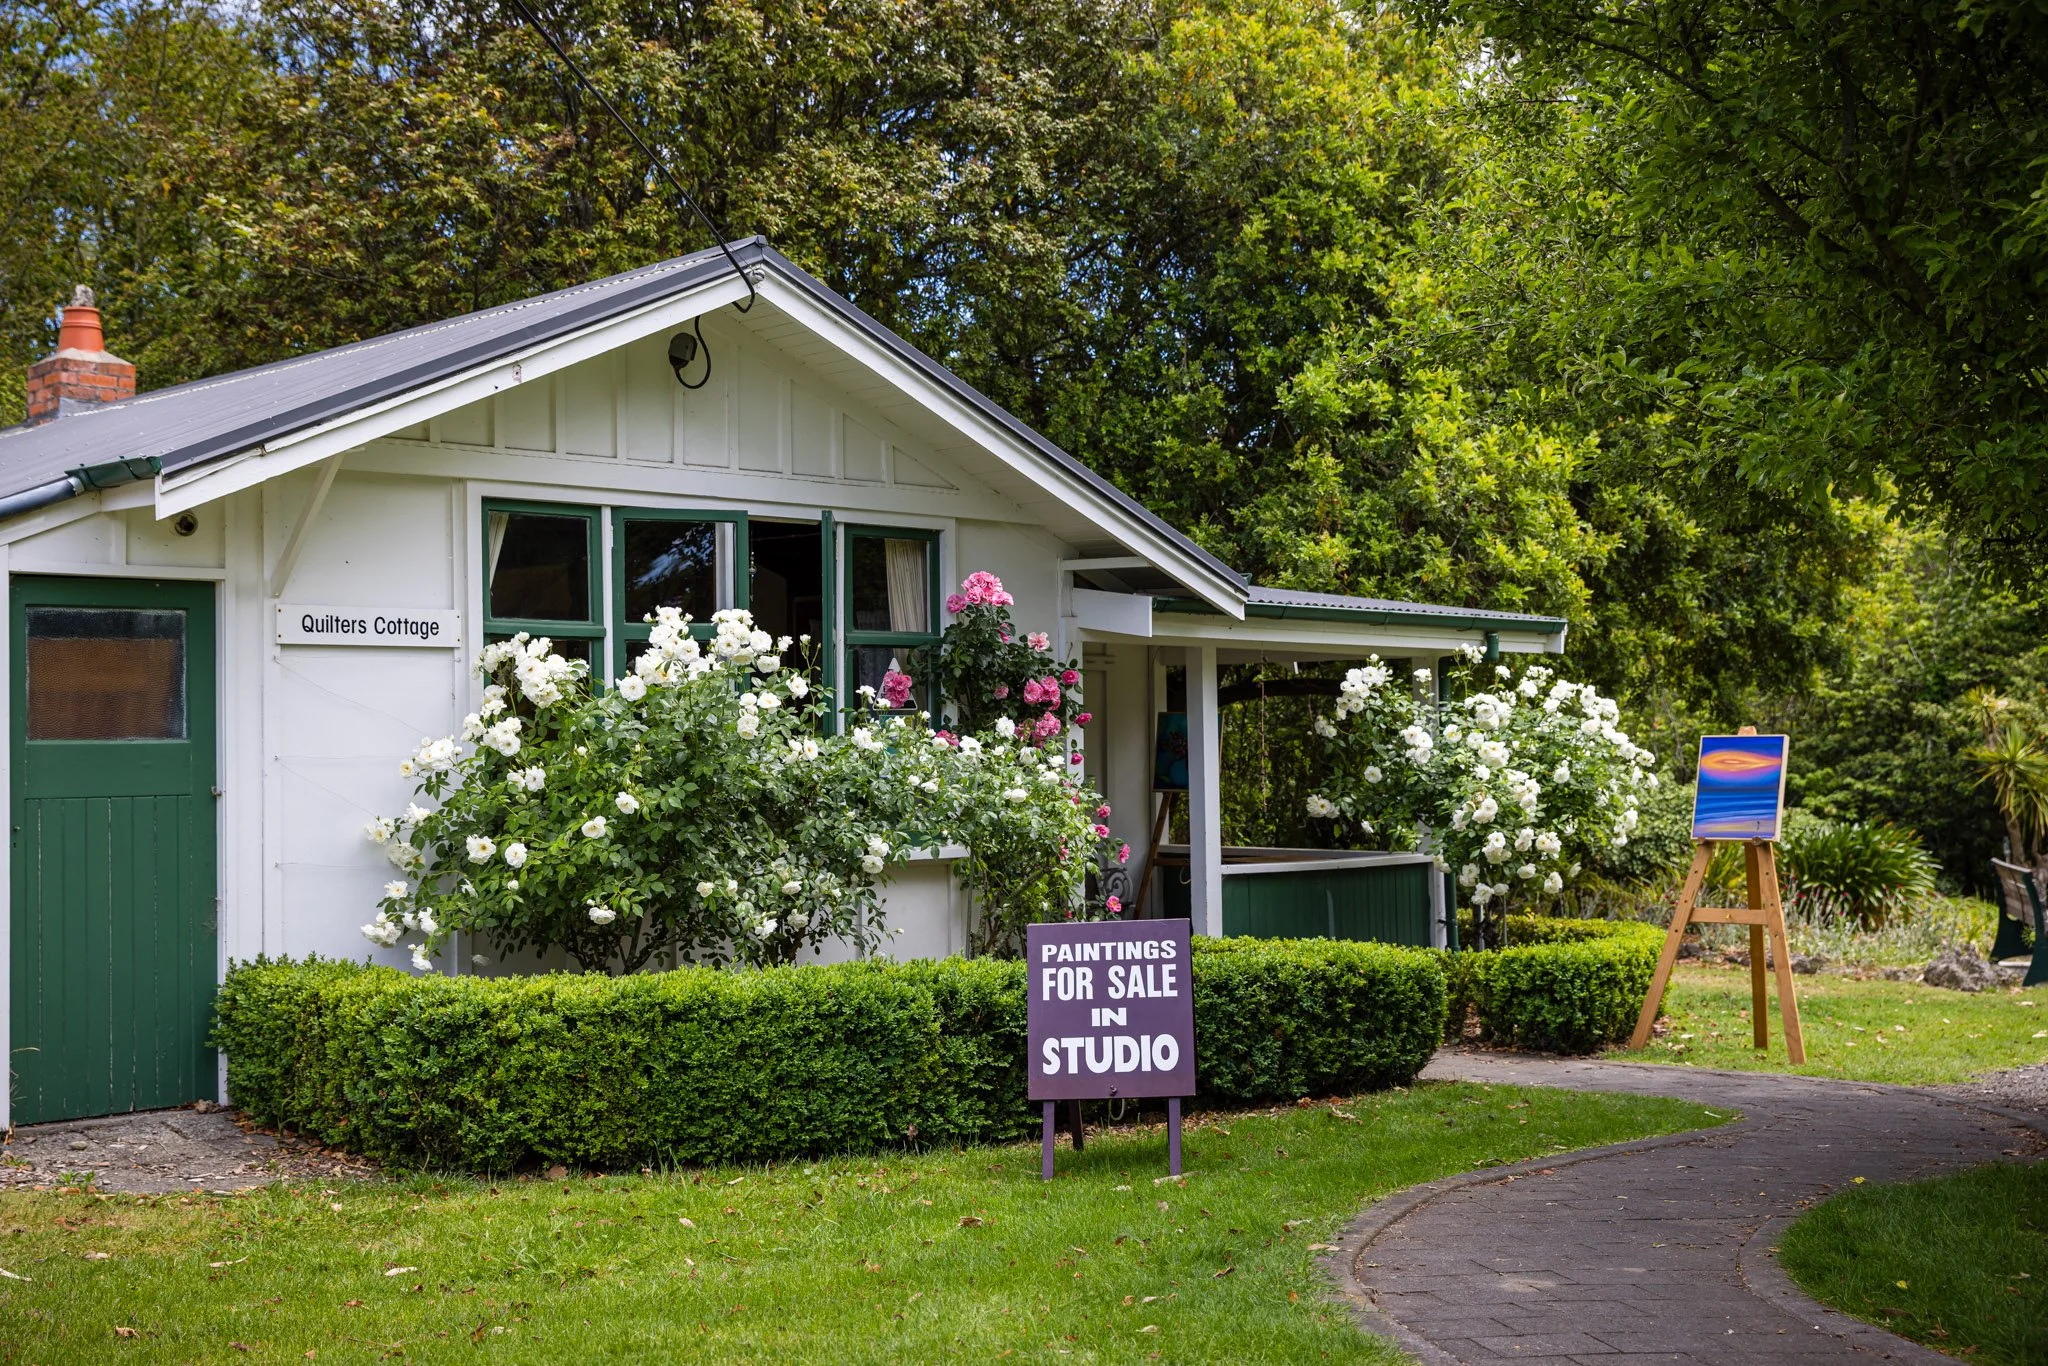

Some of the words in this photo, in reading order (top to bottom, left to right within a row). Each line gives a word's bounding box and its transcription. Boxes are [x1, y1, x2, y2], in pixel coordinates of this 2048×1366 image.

[301, 613, 368, 634] Quilters
[373, 616, 440, 640] Cottage
[1041, 939, 1177, 963] PAINTINGS
[1042, 966, 1094, 1001] FOR
[1107, 963, 1178, 1000] SALE
[1091, 1006, 1128, 1027] IN
[1042, 1033, 1180, 1075] STUDIO
